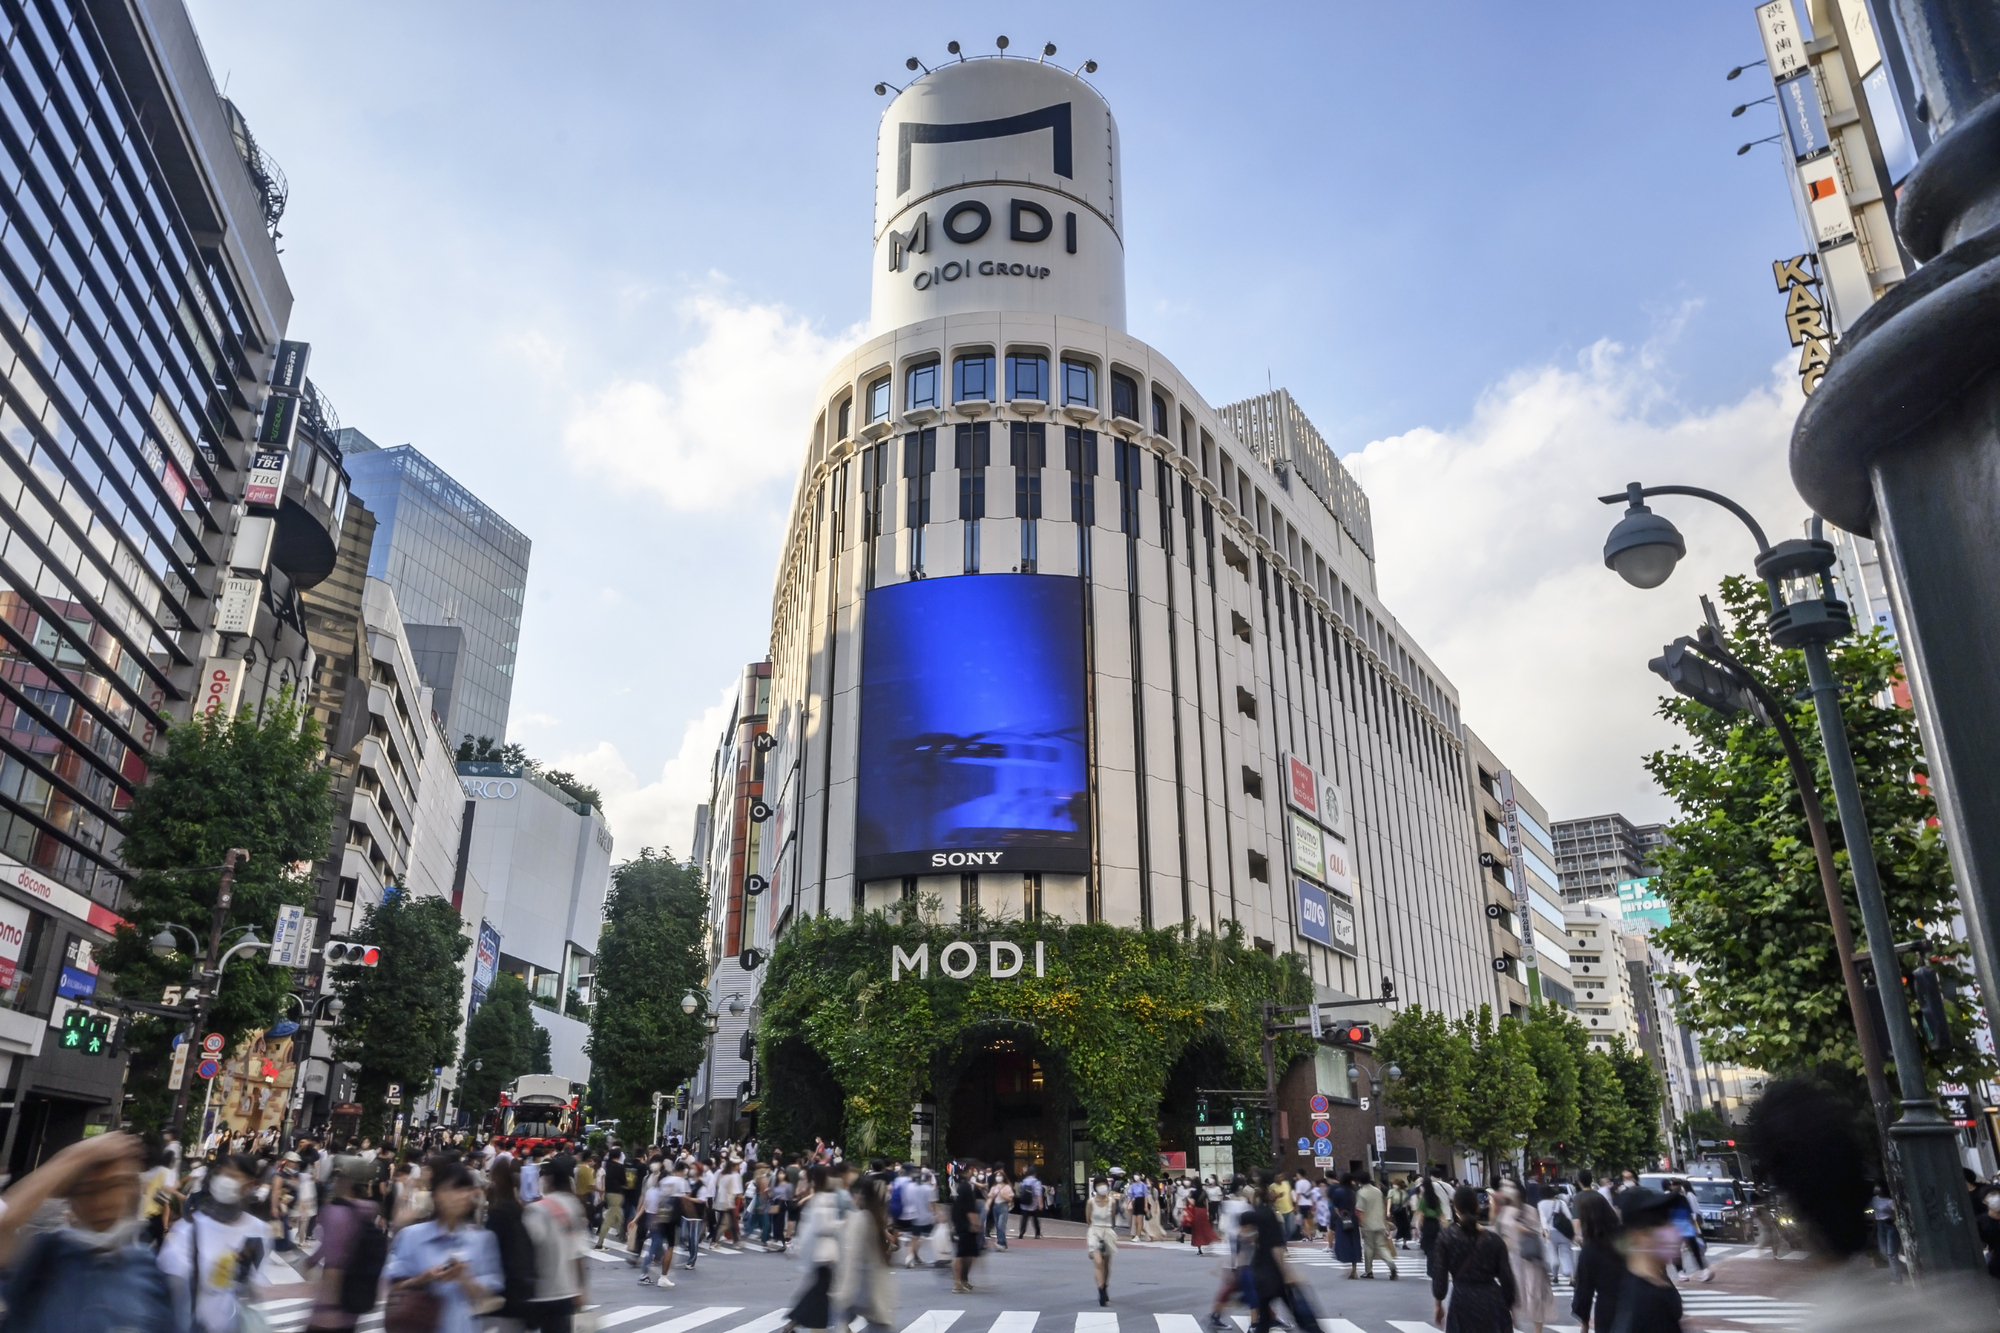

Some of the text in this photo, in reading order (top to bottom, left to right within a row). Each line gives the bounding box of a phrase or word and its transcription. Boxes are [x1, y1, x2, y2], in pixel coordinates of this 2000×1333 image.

[889, 198, 1077, 272] MODI
[978, 260, 1050, 279] GROUP
[256, 458, 281, 469] TBC
[252, 474, 278, 485] TBC
[228, 580, 255, 597] my
[204, 669, 231, 720] doco
[1295, 768, 1309, 782] HMV
[462, 779, 518, 800] ARCO
[1294, 787, 1314, 805] BOOKS
[1507, 813, 1519, 854] 日本生命
[932, 852, 1004, 867] SONY
[1330, 854, 1346, 877] au
[18, 869, 51, 899] docomo
[1620, 882, 1650, 900] ニト
[1303, 898, 1326, 927] HIS
[275, 917, 287, 942] Jinnan
[281, 909, 300, 962] 神南一丁目
[891, 940, 1044, 982] MODI
[161, 985, 182, 1007] 5
[208, 1039, 221, 1048] 30
[388, 1084, 400, 1097] P
[1360, 1097, 1370, 1111] 5
[1317, 1142, 1325, 1154] P
